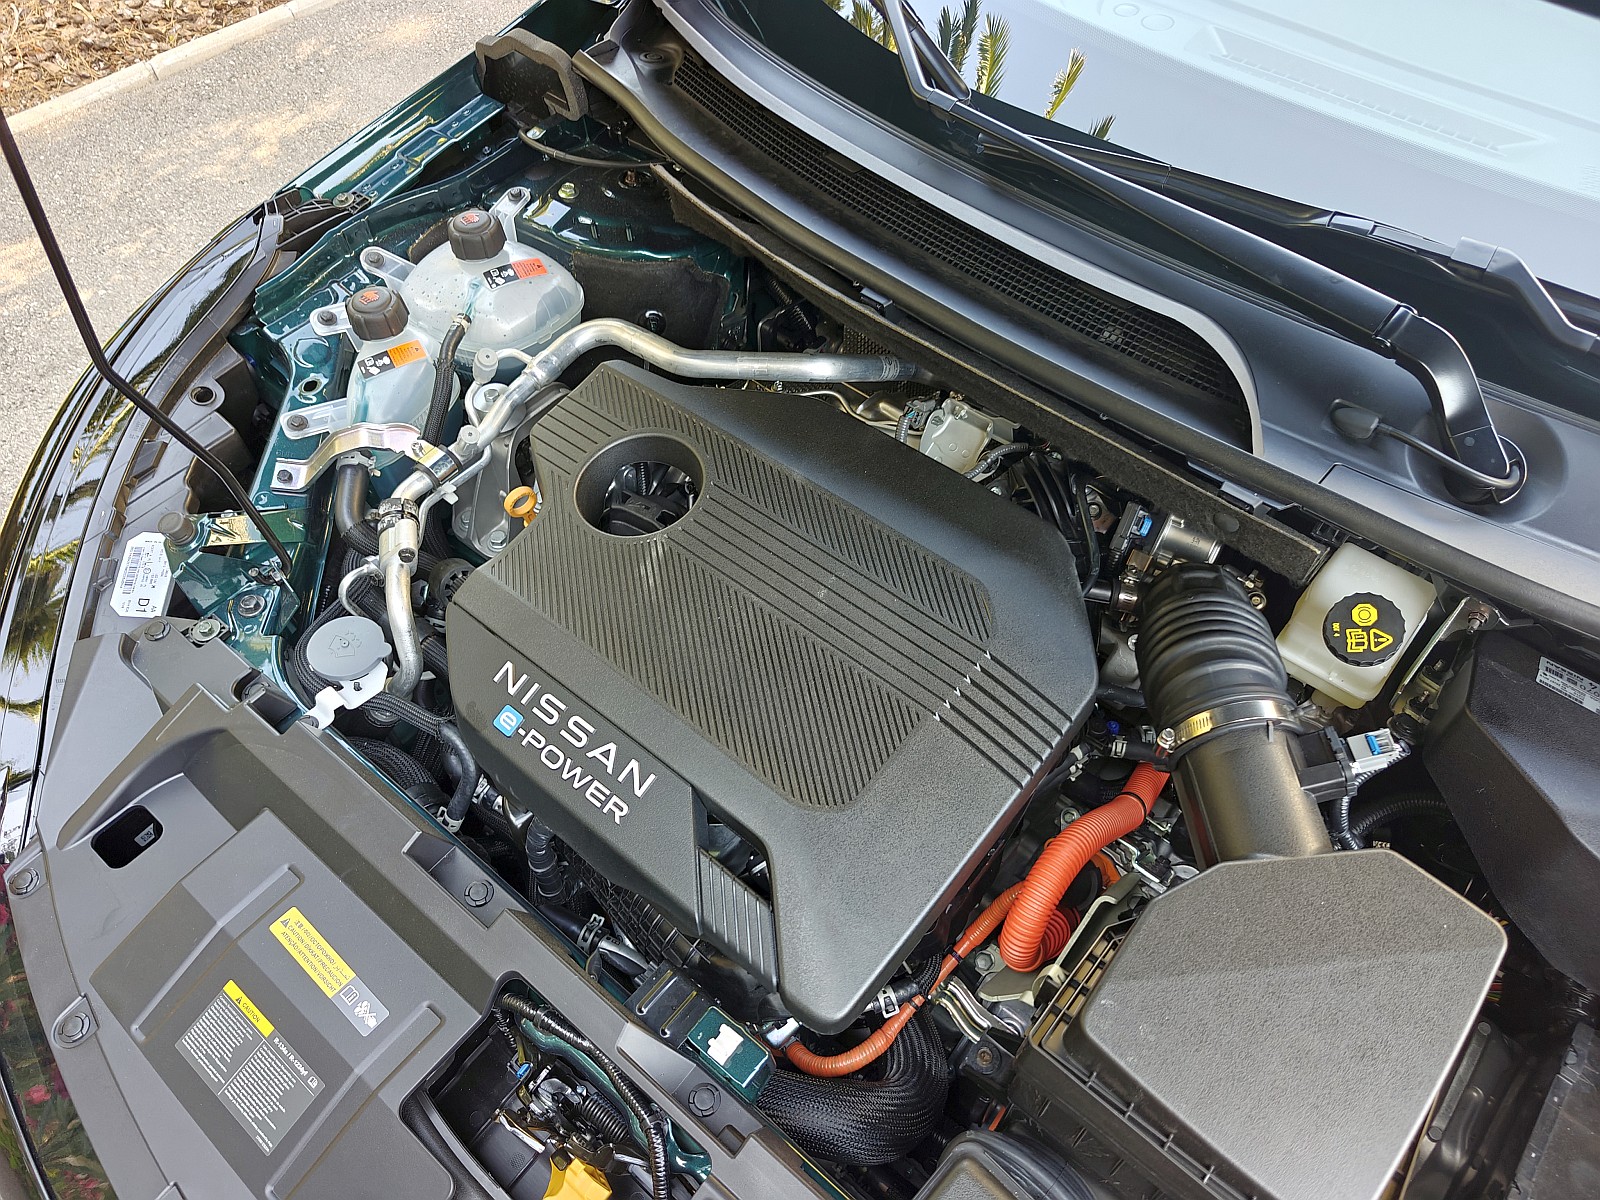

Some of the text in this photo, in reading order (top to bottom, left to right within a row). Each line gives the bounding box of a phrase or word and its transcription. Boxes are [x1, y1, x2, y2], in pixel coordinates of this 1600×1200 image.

[1546, 660, 1584, 681] NISSAN
[493, 660, 657, 798] NISSAN
[496, 708, 630, 825] e-POWER
[242, 1002, 260, 1023] CAUTION
